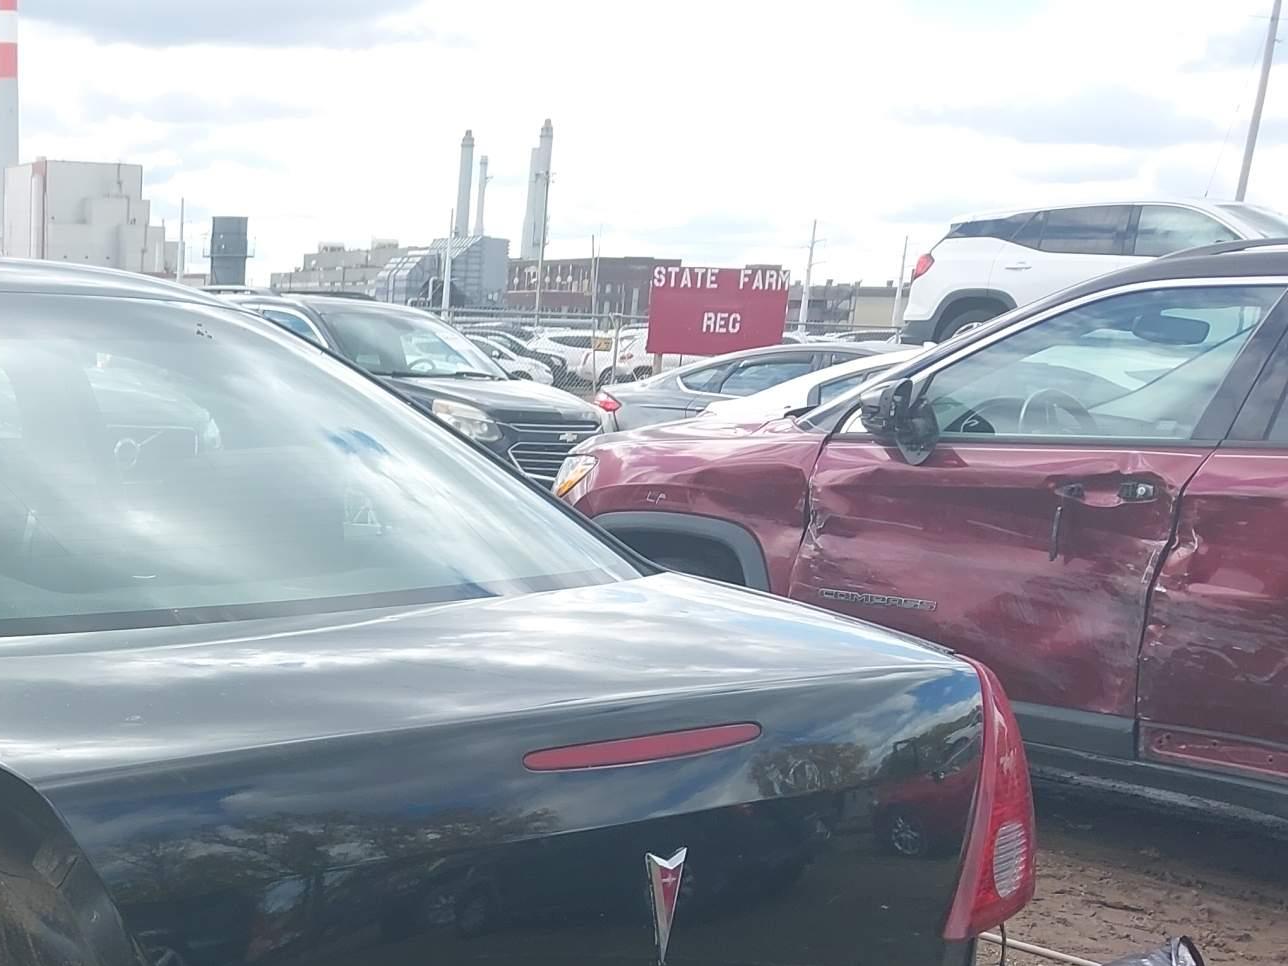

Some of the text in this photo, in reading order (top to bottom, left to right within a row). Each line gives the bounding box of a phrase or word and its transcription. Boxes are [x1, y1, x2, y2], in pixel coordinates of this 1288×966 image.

[653, 267, 791, 291] STATE FARM
[819, 588, 937, 612] COMPASS
